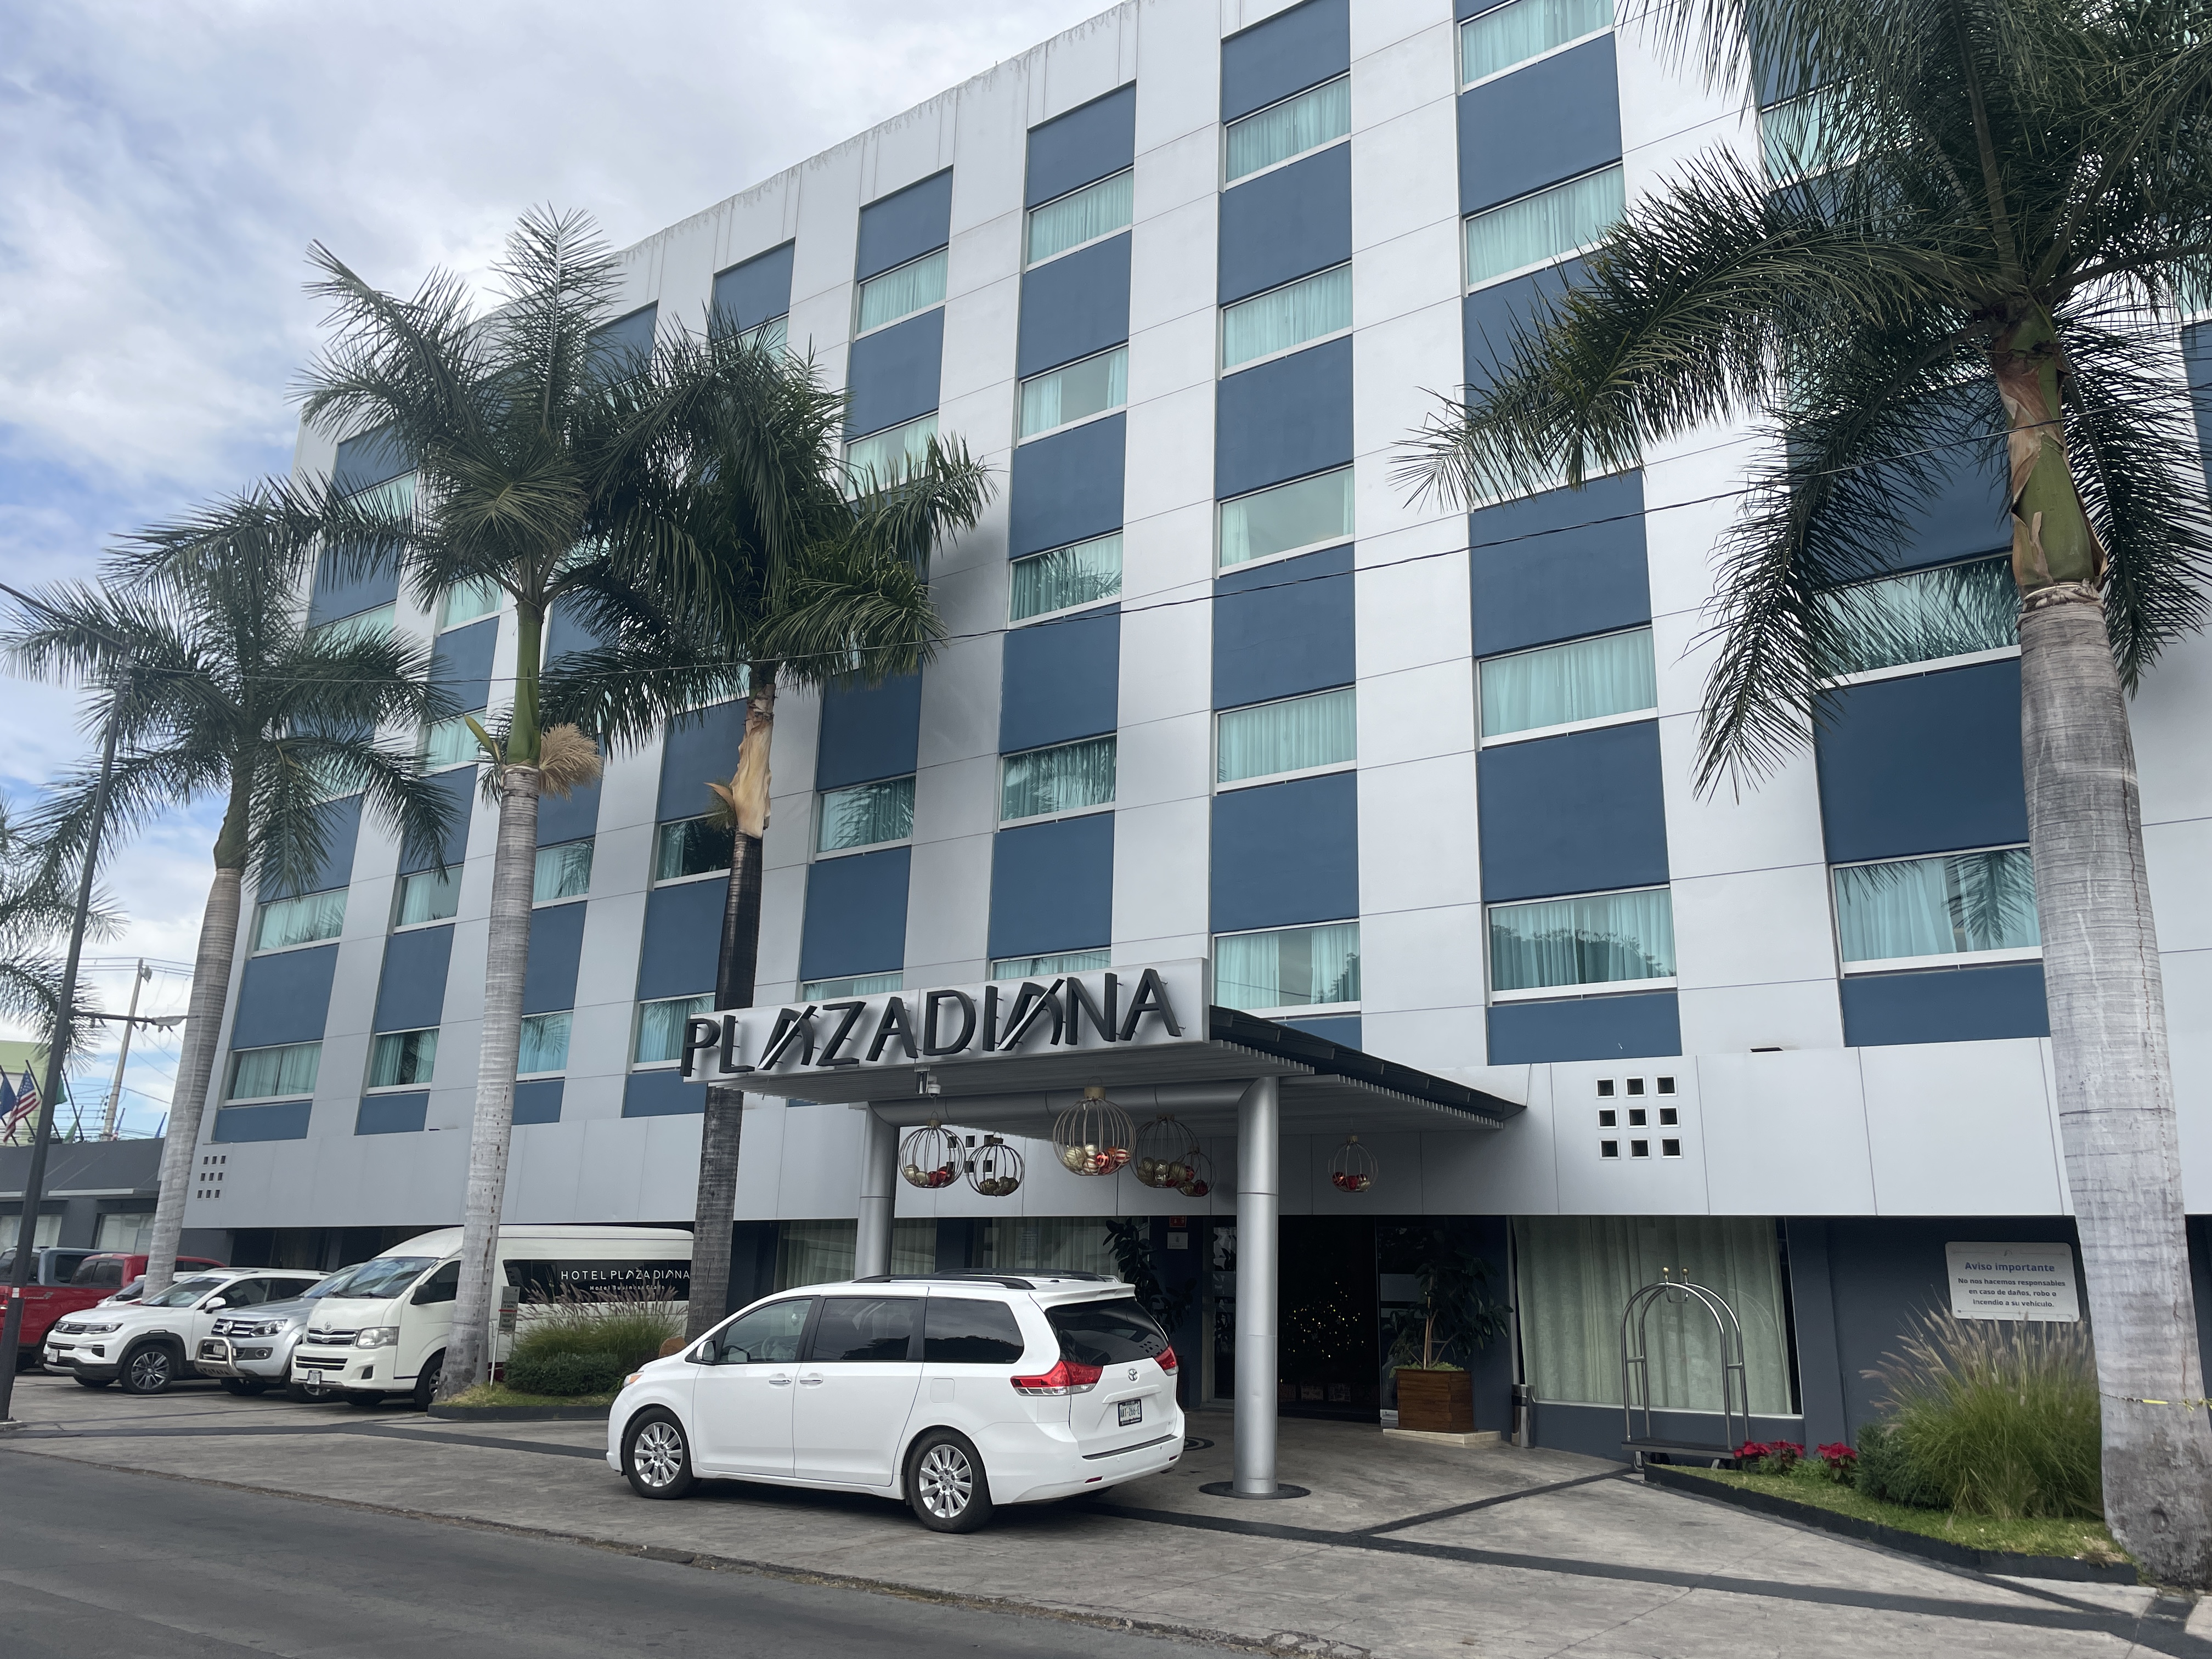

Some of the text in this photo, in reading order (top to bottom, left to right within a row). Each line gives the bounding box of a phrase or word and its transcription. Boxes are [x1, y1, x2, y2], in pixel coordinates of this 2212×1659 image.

[1965, 1262, 2055, 1273] Aviso importante
[561, 1270, 606, 1280] HOTEL
